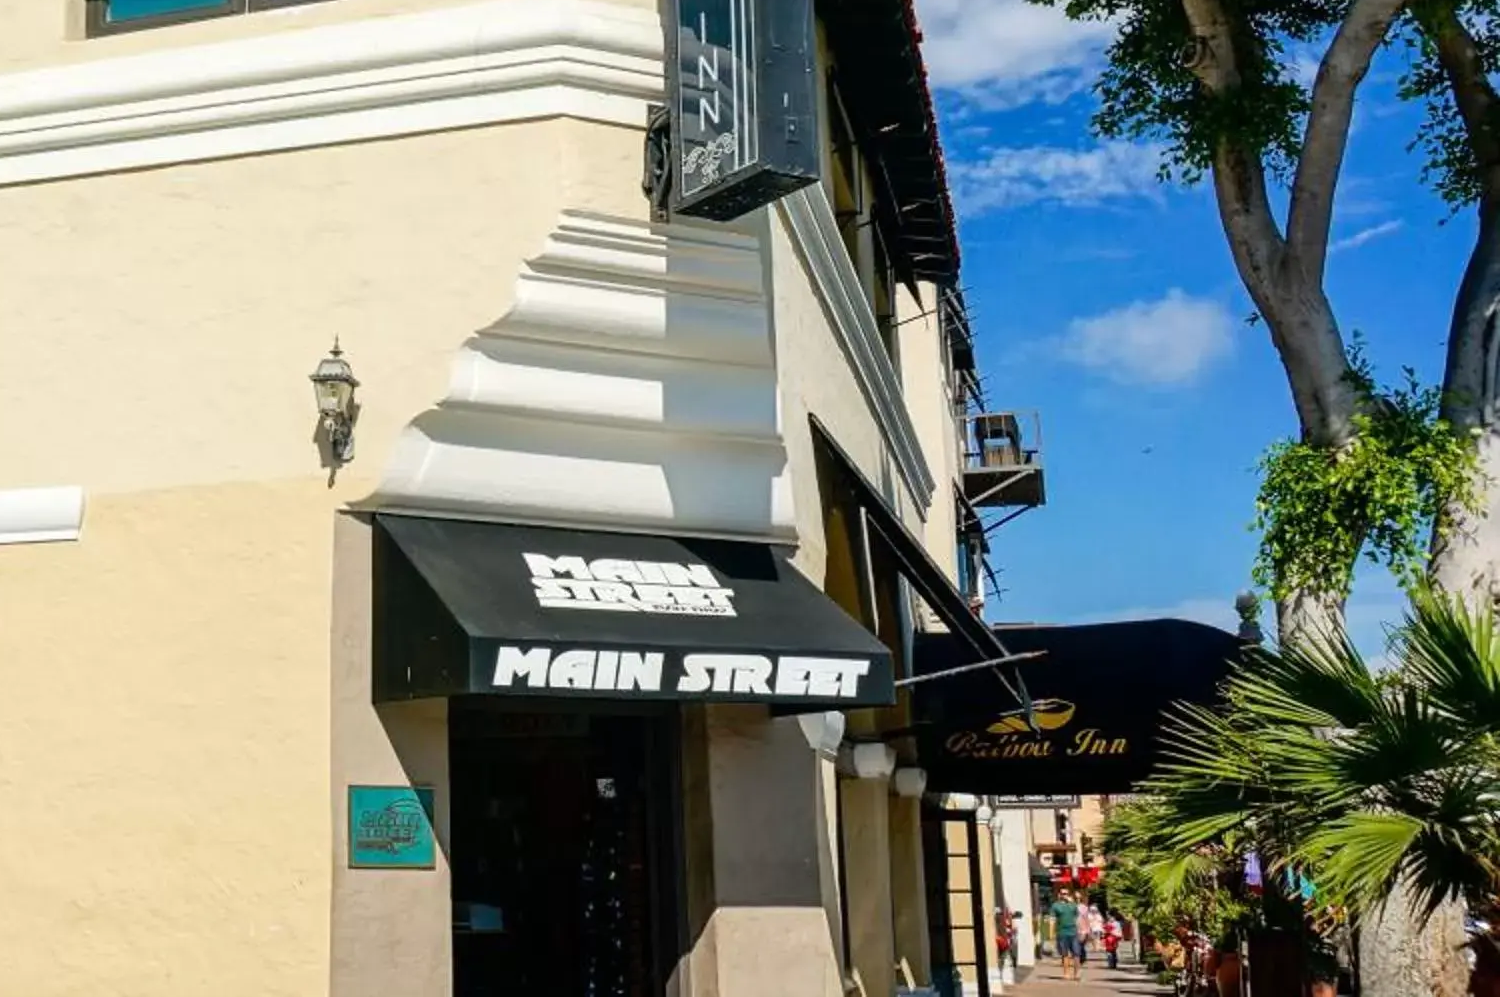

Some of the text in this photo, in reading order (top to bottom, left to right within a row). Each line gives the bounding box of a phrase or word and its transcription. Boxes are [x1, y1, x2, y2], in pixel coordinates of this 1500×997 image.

[698, 10, 720, 133] INN
[521, 552, 722, 588] MAIN
[530, 577, 737, 606] STREET
[492, 646, 871, 698] MAIN STREET
[1066, 728, 1128, 756] Inn
